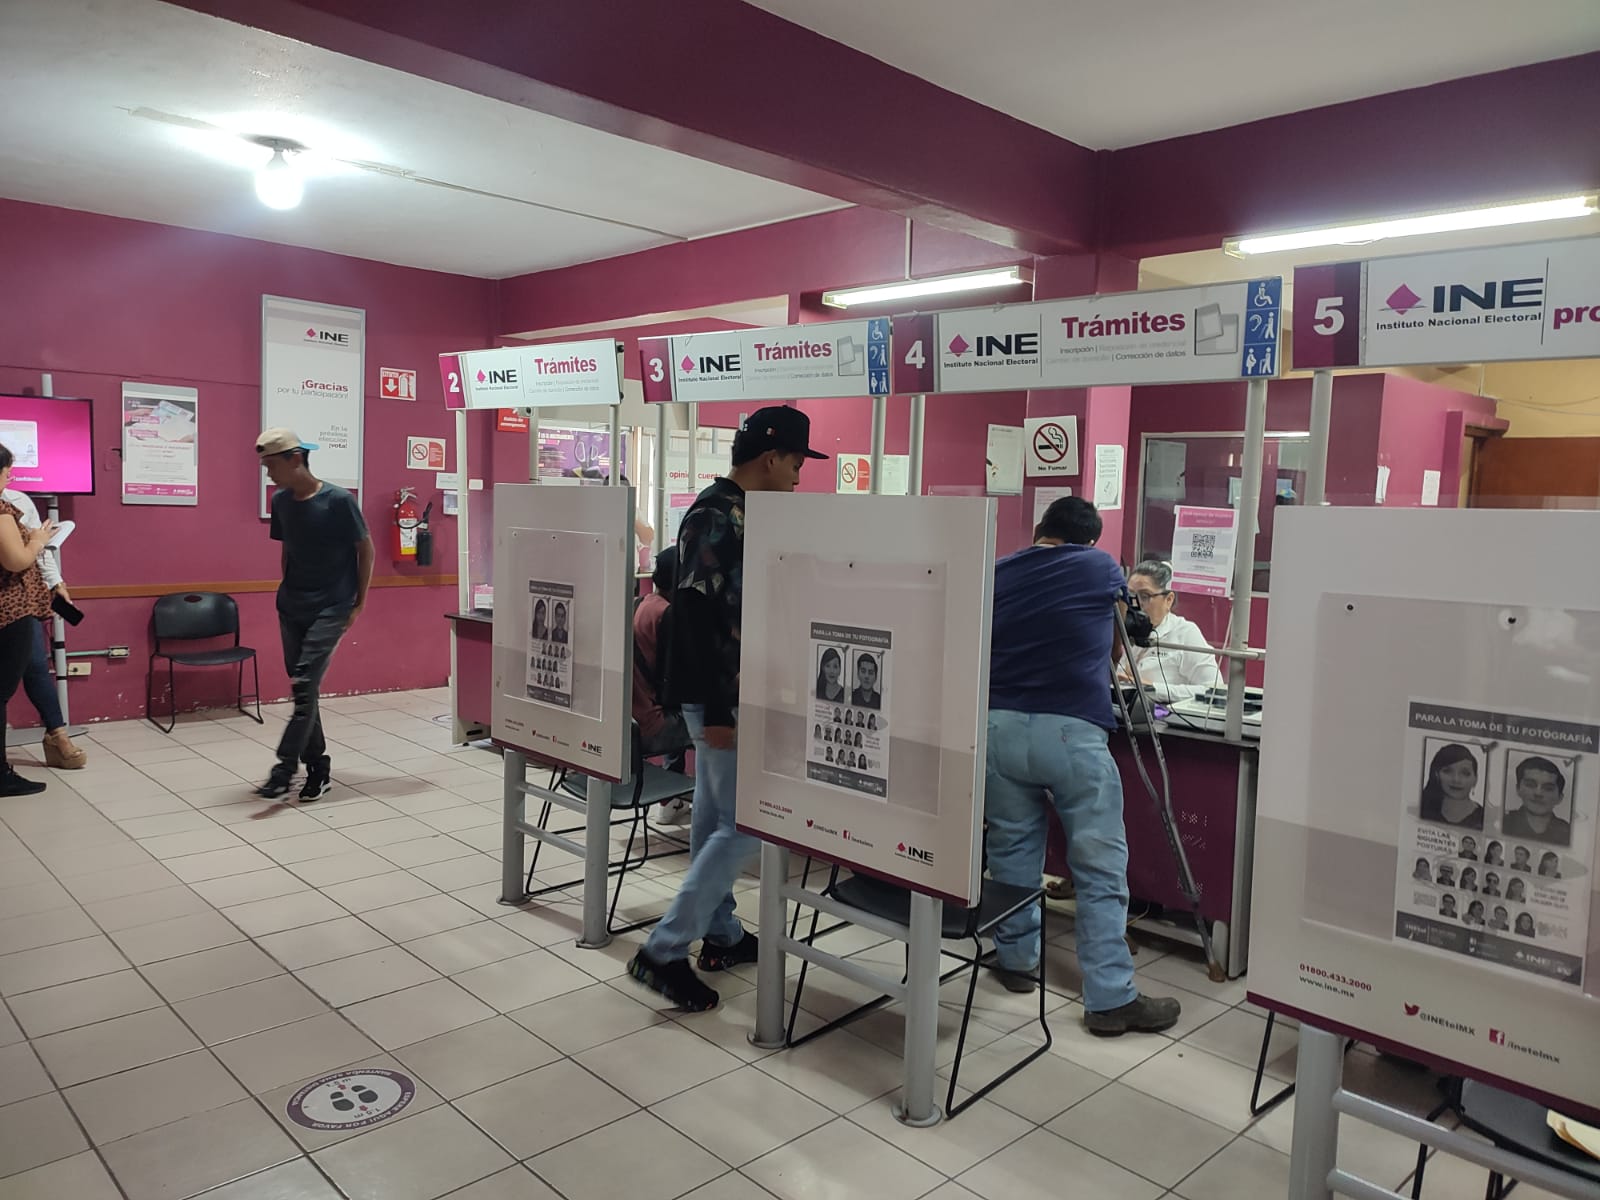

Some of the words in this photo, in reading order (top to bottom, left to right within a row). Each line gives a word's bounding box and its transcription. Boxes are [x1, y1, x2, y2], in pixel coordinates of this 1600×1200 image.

[1433, 278, 1543, 313] INE
[1061, 311, 1186, 338] Trámites
[1313, 297, 1344, 335] 5
[1376, 319, 1424, 330] Instituto
[1428, 316, 1480, 327] Nacional
[1485, 312, 1541, 324] Electoral
[319, 330, 349, 343] INE
[976, 333, 1038, 356] INE
[754, 340, 832, 361] Trámites
[904, 340, 926, 369] 4
[534, 356, 597, 375] Trámites
[649, 357, 664, 382] 3
[699, 354, 740, 374] INE
[944, 360, 972, 369] Instituto
[974, 359, 1004, 367] Nacional
[1006, 357, 1038, 365] Electoral
[302, 379, 349, 392] ¡Gracias
[447, 372, 460, 393] 2
[488, 369, 517, 384] INE
[1415, 713, 1441, 724] PARA
[1443, 716, 1456, 726] LA
[1459, 718, 1487, 731] TOMA
[1489, 721, 1503, 733] DE
[1507, 724, 1520, 735] TU
[1522, 724, 1593, 745] FOTOGRAFÍA
[588, 742, 602, 754] INE
[908, 846, 934, 863] INE
[1299, 963, 1372, 992] 01800.433.2000
[1299, 975, 1355, 998] www.ine.mx
